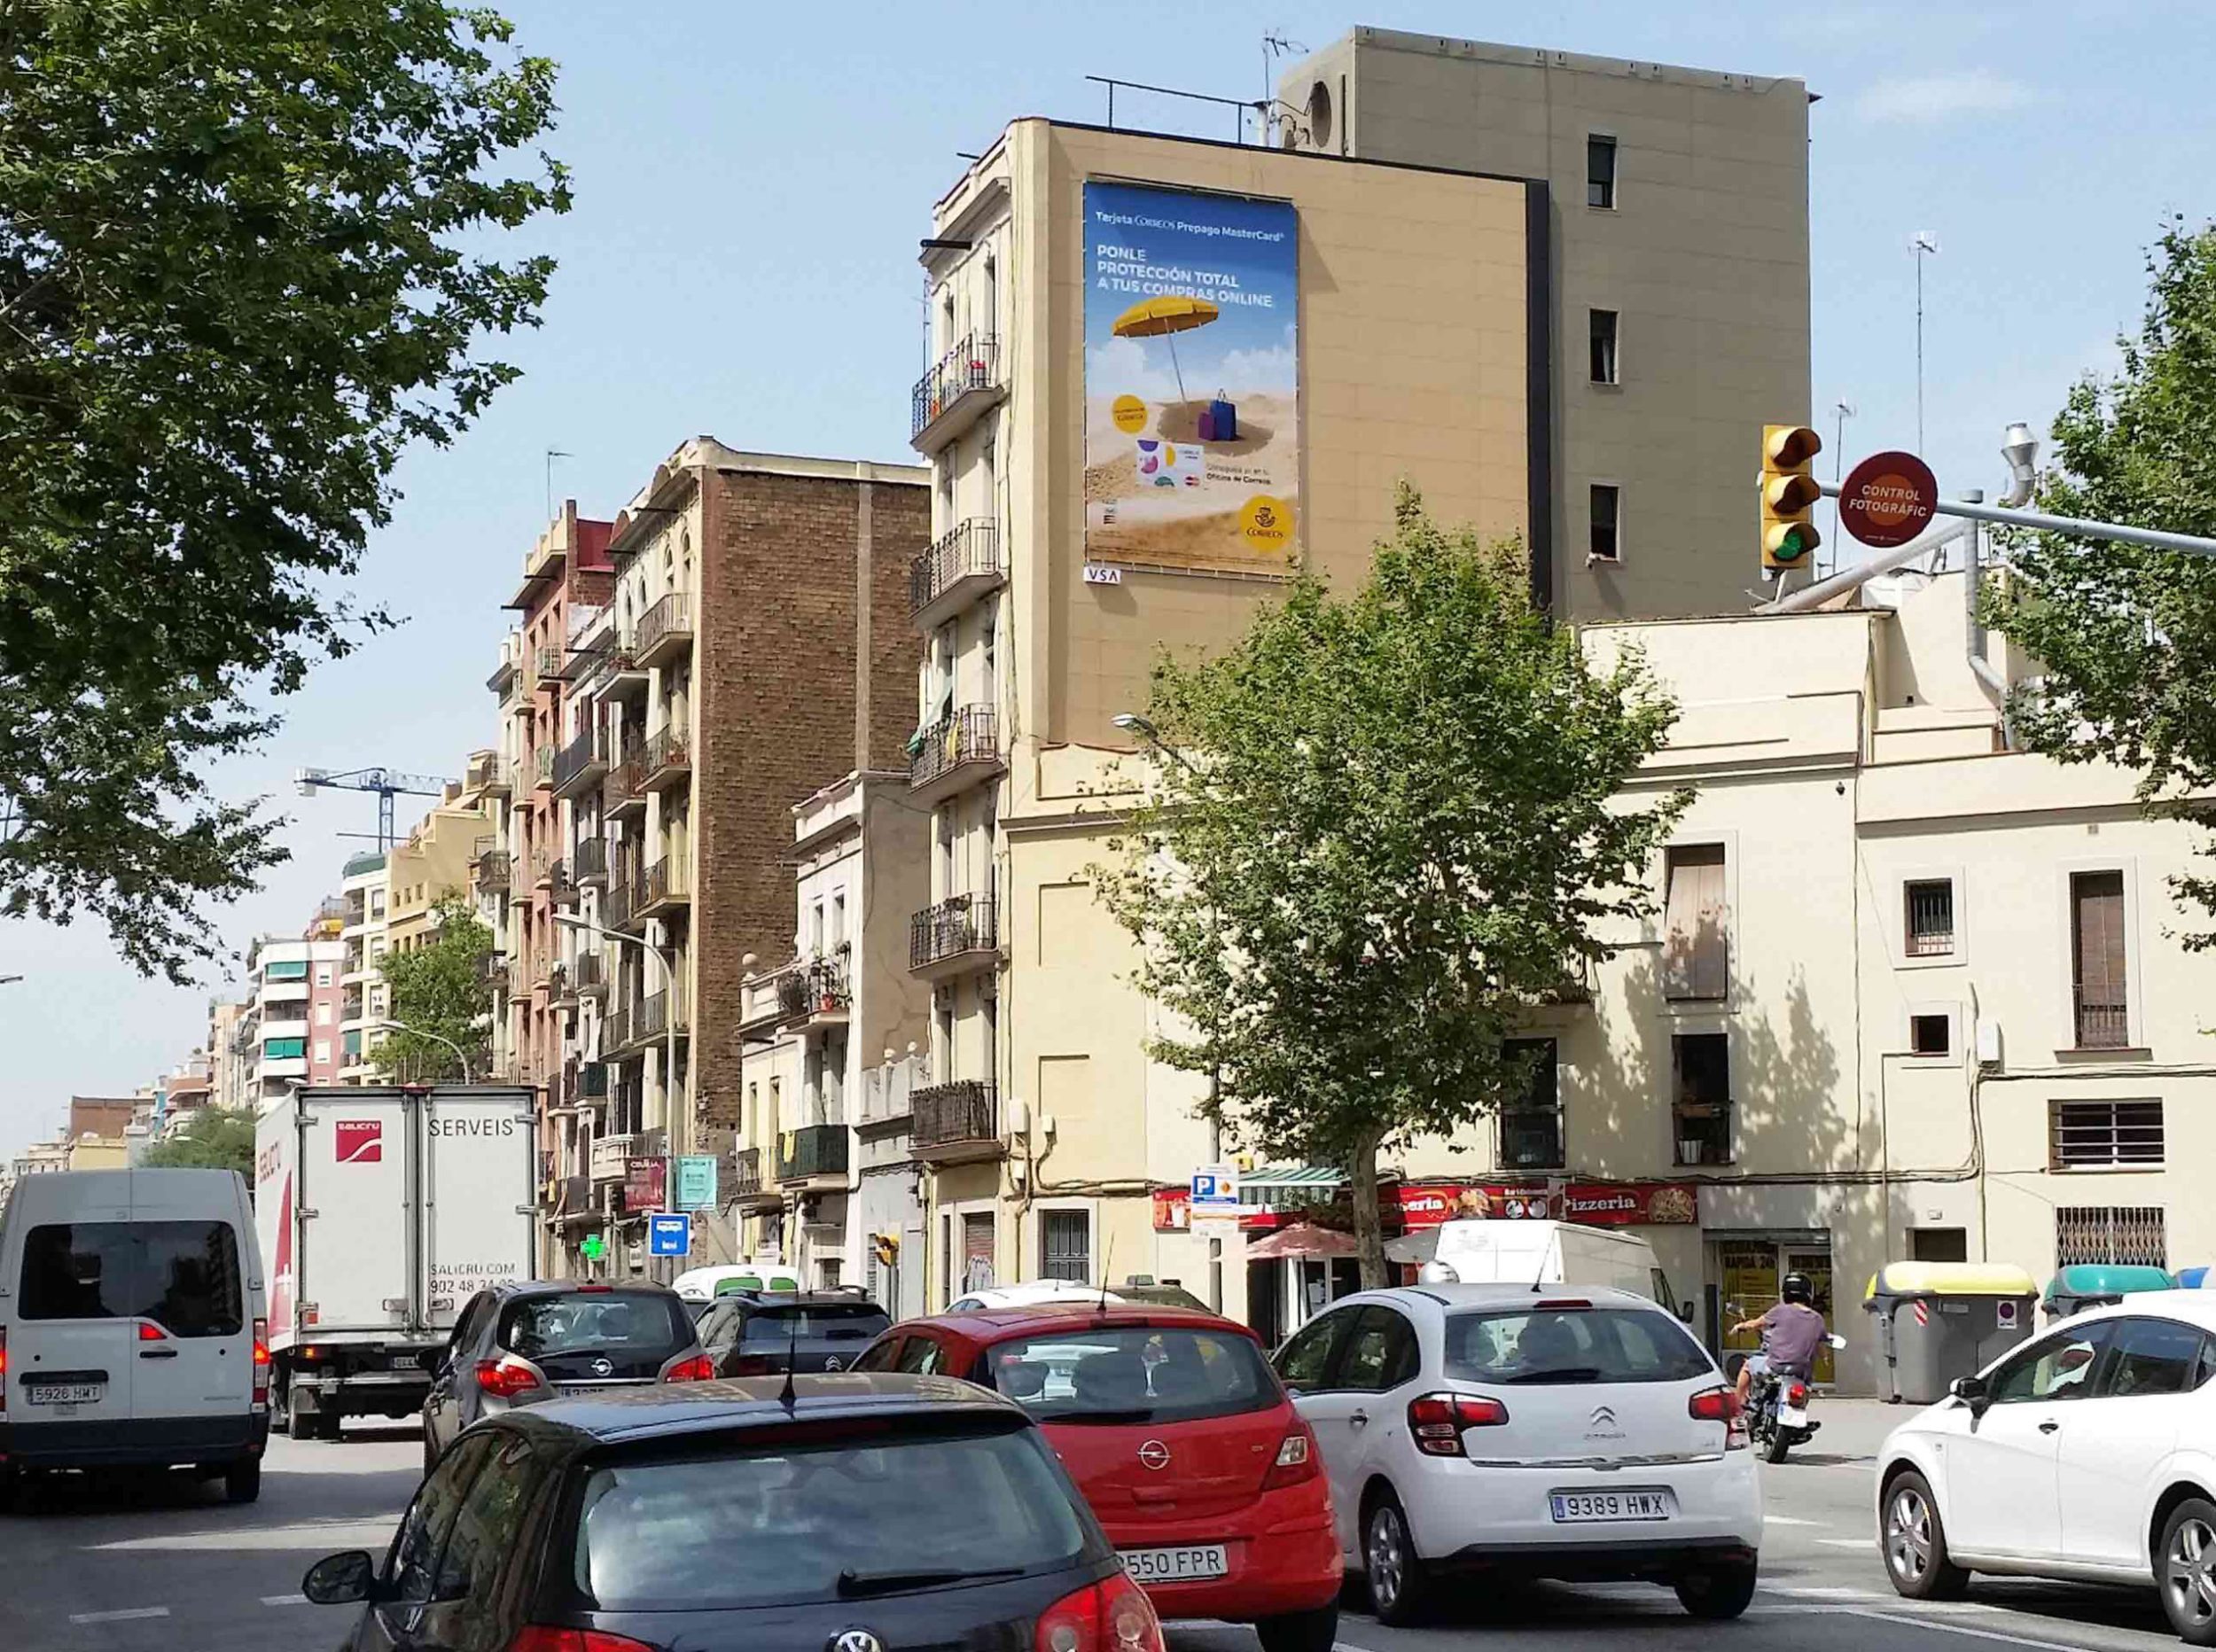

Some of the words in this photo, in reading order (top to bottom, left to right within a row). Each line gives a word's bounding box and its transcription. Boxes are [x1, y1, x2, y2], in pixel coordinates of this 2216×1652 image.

[1177, 222, 1221, 237] Prepago
[1096, 245, 1147, 261] PONLE
[1096, 261, 1191, 282] PROTECCIÓN
[1194, 271, 1239, 288] TOTAL
[1097, 277, 1109, 290] A
[1111, 277, 1140, 292] TUS
[1143, 282, 1213, 300] COMPRAS
[1218, 290, 1274, 308] ONLINE
[1861, 485, 1921, 501] CONTROL
[429, 1118, 513, 1136] SERVEIS
[1197, 1177, 1211, 1194] P
[431, 1280, 455, 1293] 902
[459, 1280, 474, 1292] 48
[1568, 1496, 1619, 1516] 9389
[1626, 1495, 1664, 1515] HWX
[1176, 1550, 1221, 1572] FPR
